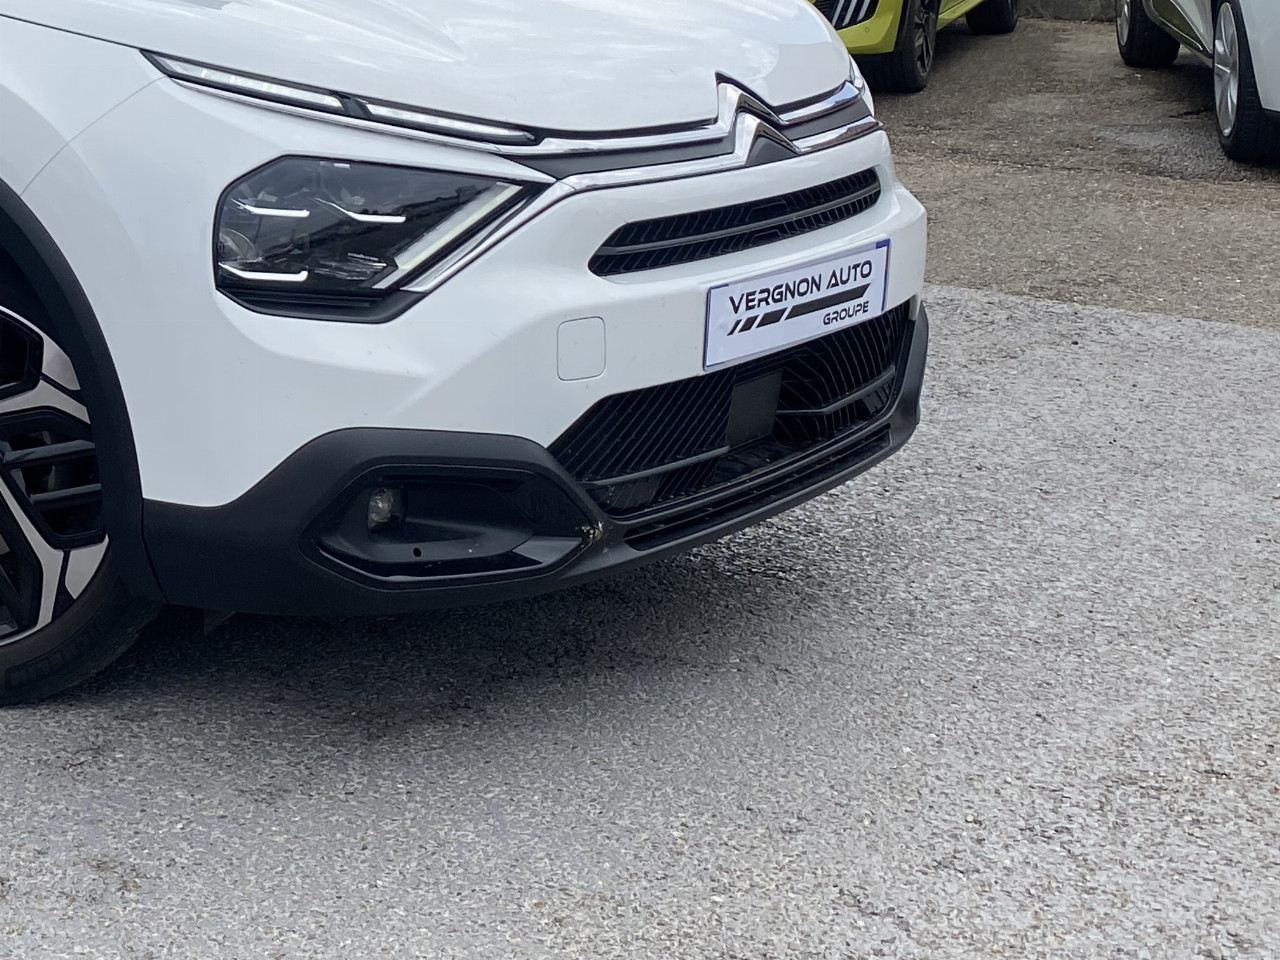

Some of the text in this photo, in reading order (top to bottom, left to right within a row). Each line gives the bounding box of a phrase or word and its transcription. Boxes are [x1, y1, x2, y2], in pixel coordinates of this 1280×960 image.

[728, 259, 873, 315] VERGNON AUTO
[823, 300, 870, 326] GROUPE
